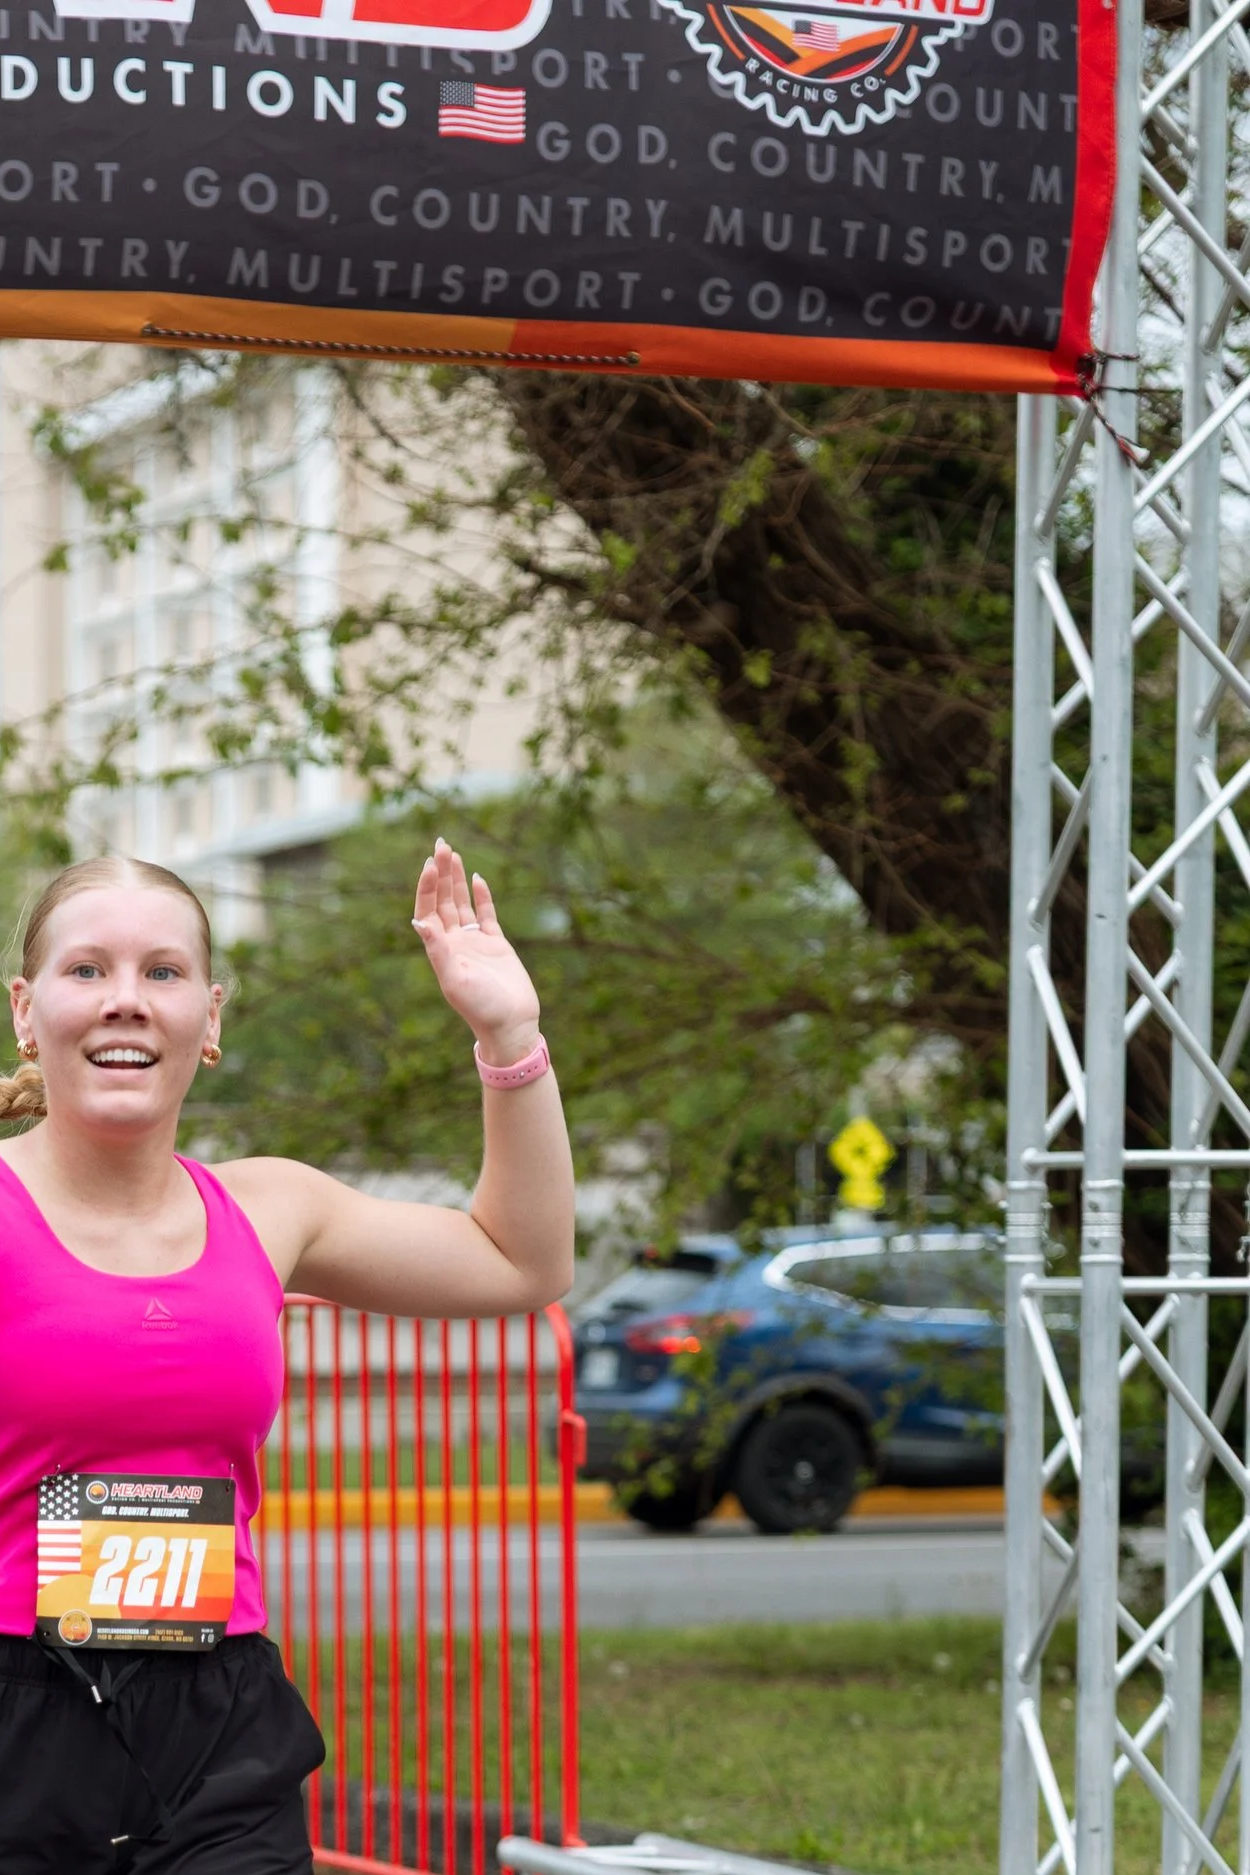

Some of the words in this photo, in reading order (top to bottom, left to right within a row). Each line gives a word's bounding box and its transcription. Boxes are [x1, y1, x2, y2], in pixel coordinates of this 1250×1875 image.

[744, 56, 838, 104] RACING
[850, 74, 887, 98] CO.
[536, 120, 677, 170] GOD,
[707, 131, 1005, 204] COUNTRY,
[183, 166, 338, 225] GOD,
[369, 184, 676, 243] COUNTRY,
[227, 247, 641, 310] MULTISPORT
[698, 276, 834, 328] GOD,
[111, 1483, 203, 1500] HEARTLAND
[89, 1535, 208, 1608] 2211
